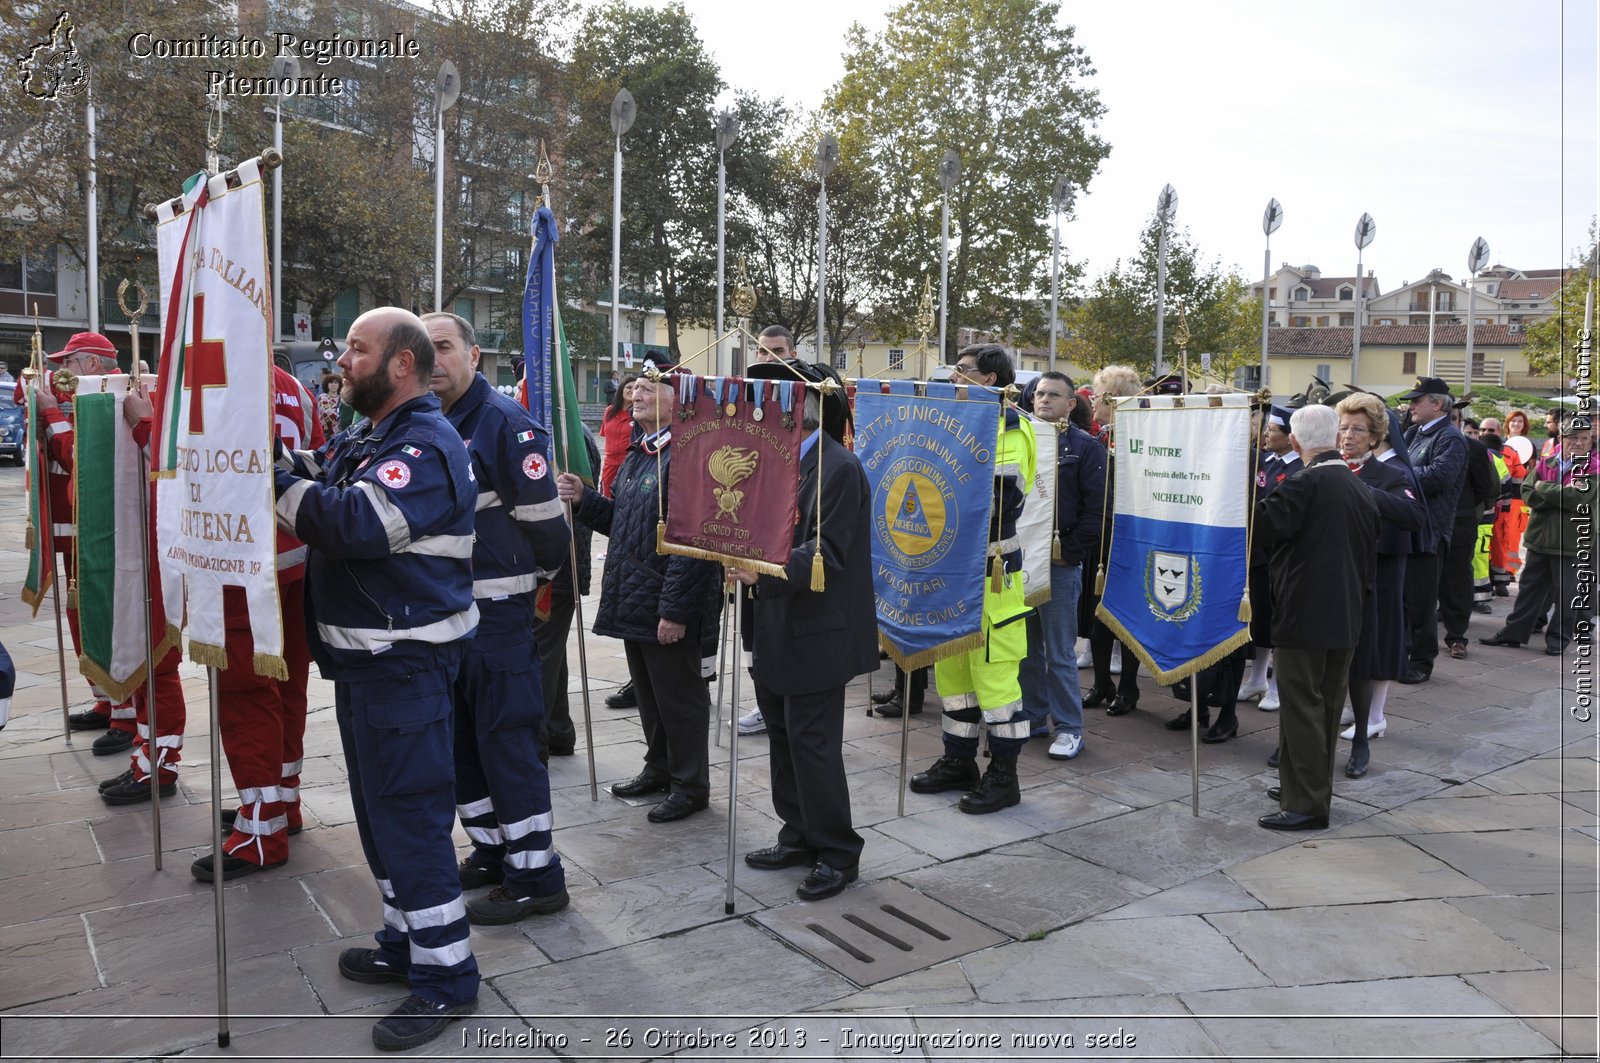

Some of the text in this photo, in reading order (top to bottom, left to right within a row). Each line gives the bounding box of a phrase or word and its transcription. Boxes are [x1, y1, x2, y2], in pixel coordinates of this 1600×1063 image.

[898, 405, 910, 421] DI
[912, 404, 991, 464] NICHELINO
[866, 432, 973, 486] GRUPPO COMUNALE
[1148, 446, 1182, 458] UNITRE
[1171, 471, 1188, 480] delle
[190, 482, 202, 503] DI
[1152, 492, 1204, 506] NICHELINO
[878, 564, 946, 595] VOLONTARI
[926, 599, 967, 625] CIVILE
